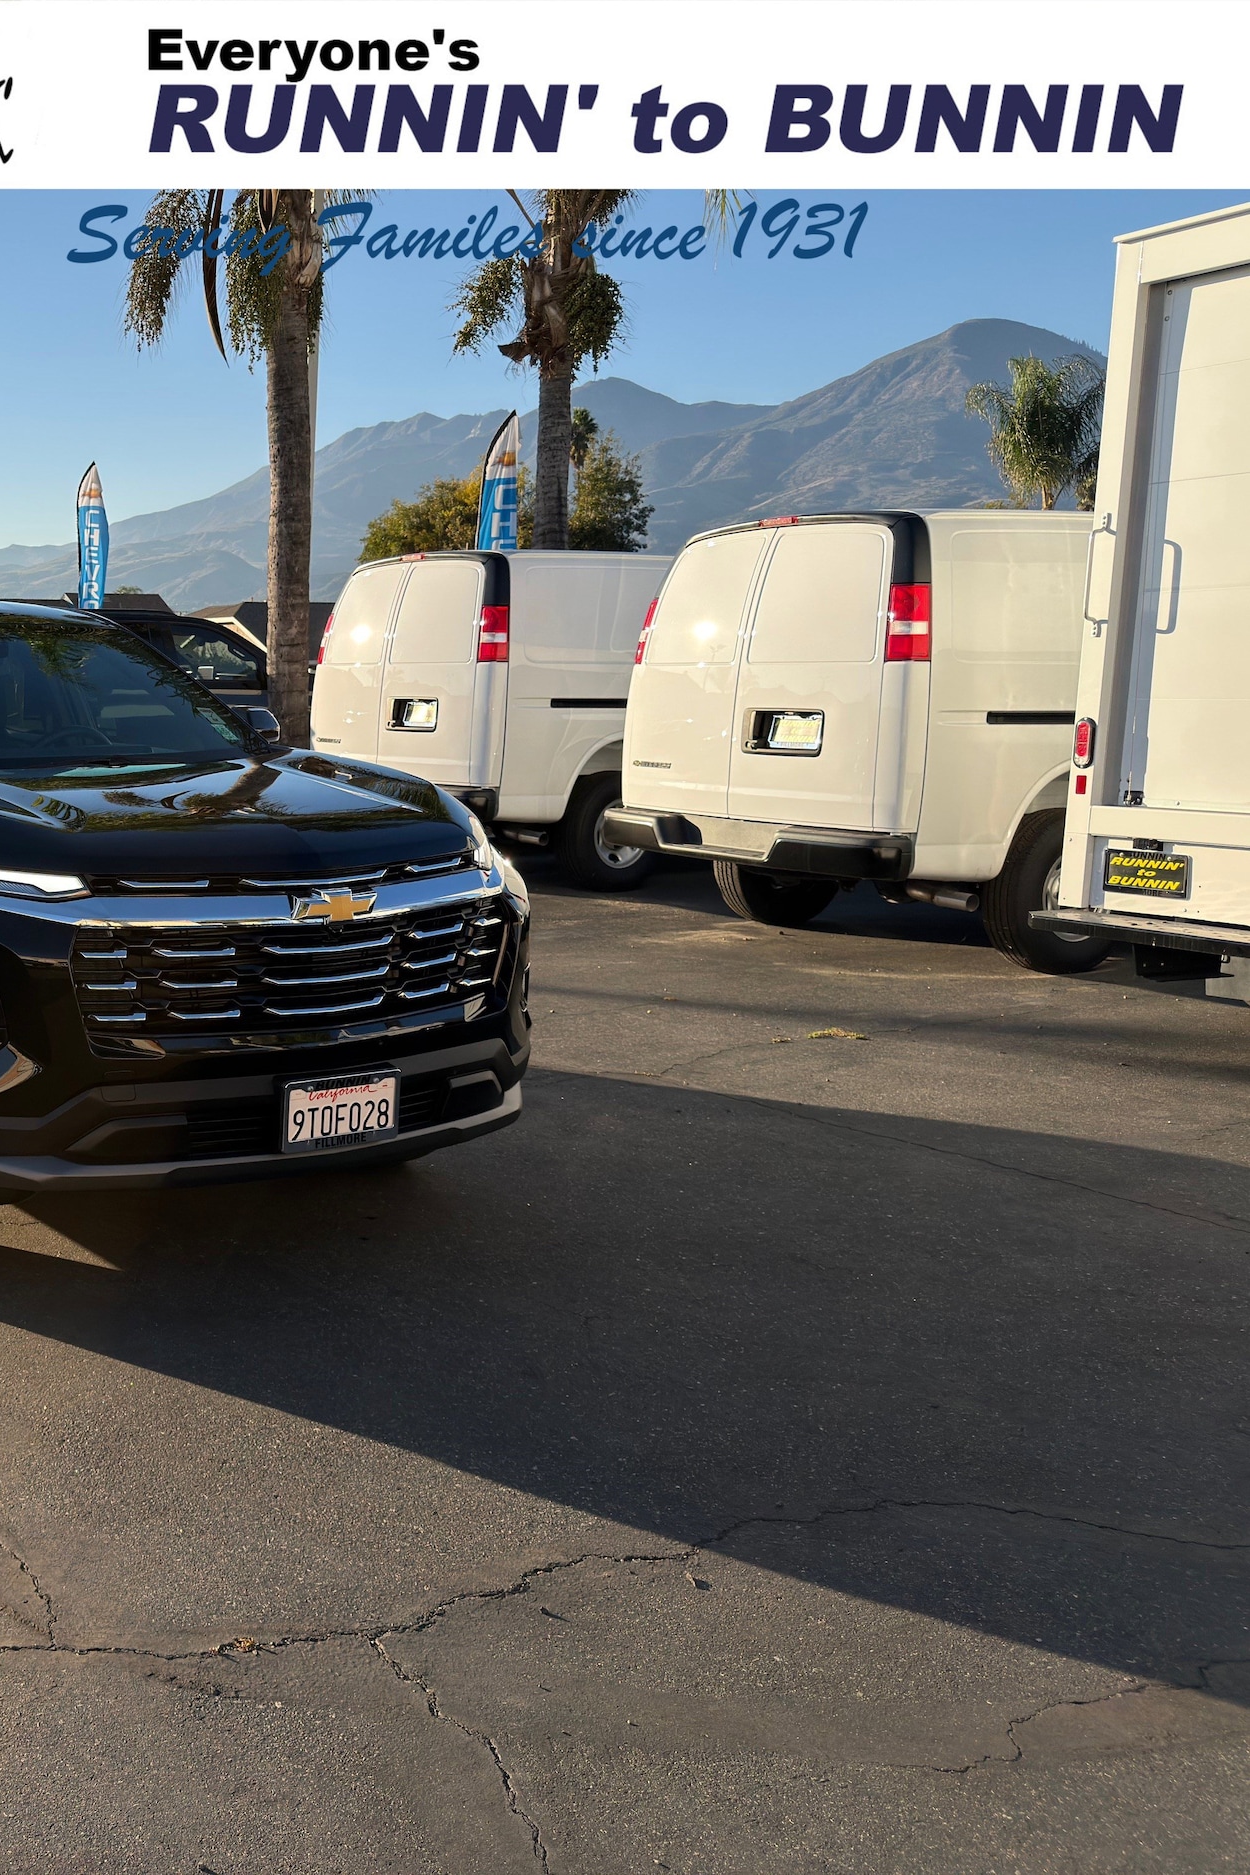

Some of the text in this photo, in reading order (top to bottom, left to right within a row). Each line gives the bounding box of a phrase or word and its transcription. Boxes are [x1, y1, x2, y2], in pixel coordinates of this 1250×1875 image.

[1110, 857, 1184, 871] RUNNIN'
[1137, 869, 1156, 877] to
[1108, 876, 1180, 890] BUNNIN
[308, 1084, 378, 1102] California
[315, 1133, 366, 1148] FILLMORE
